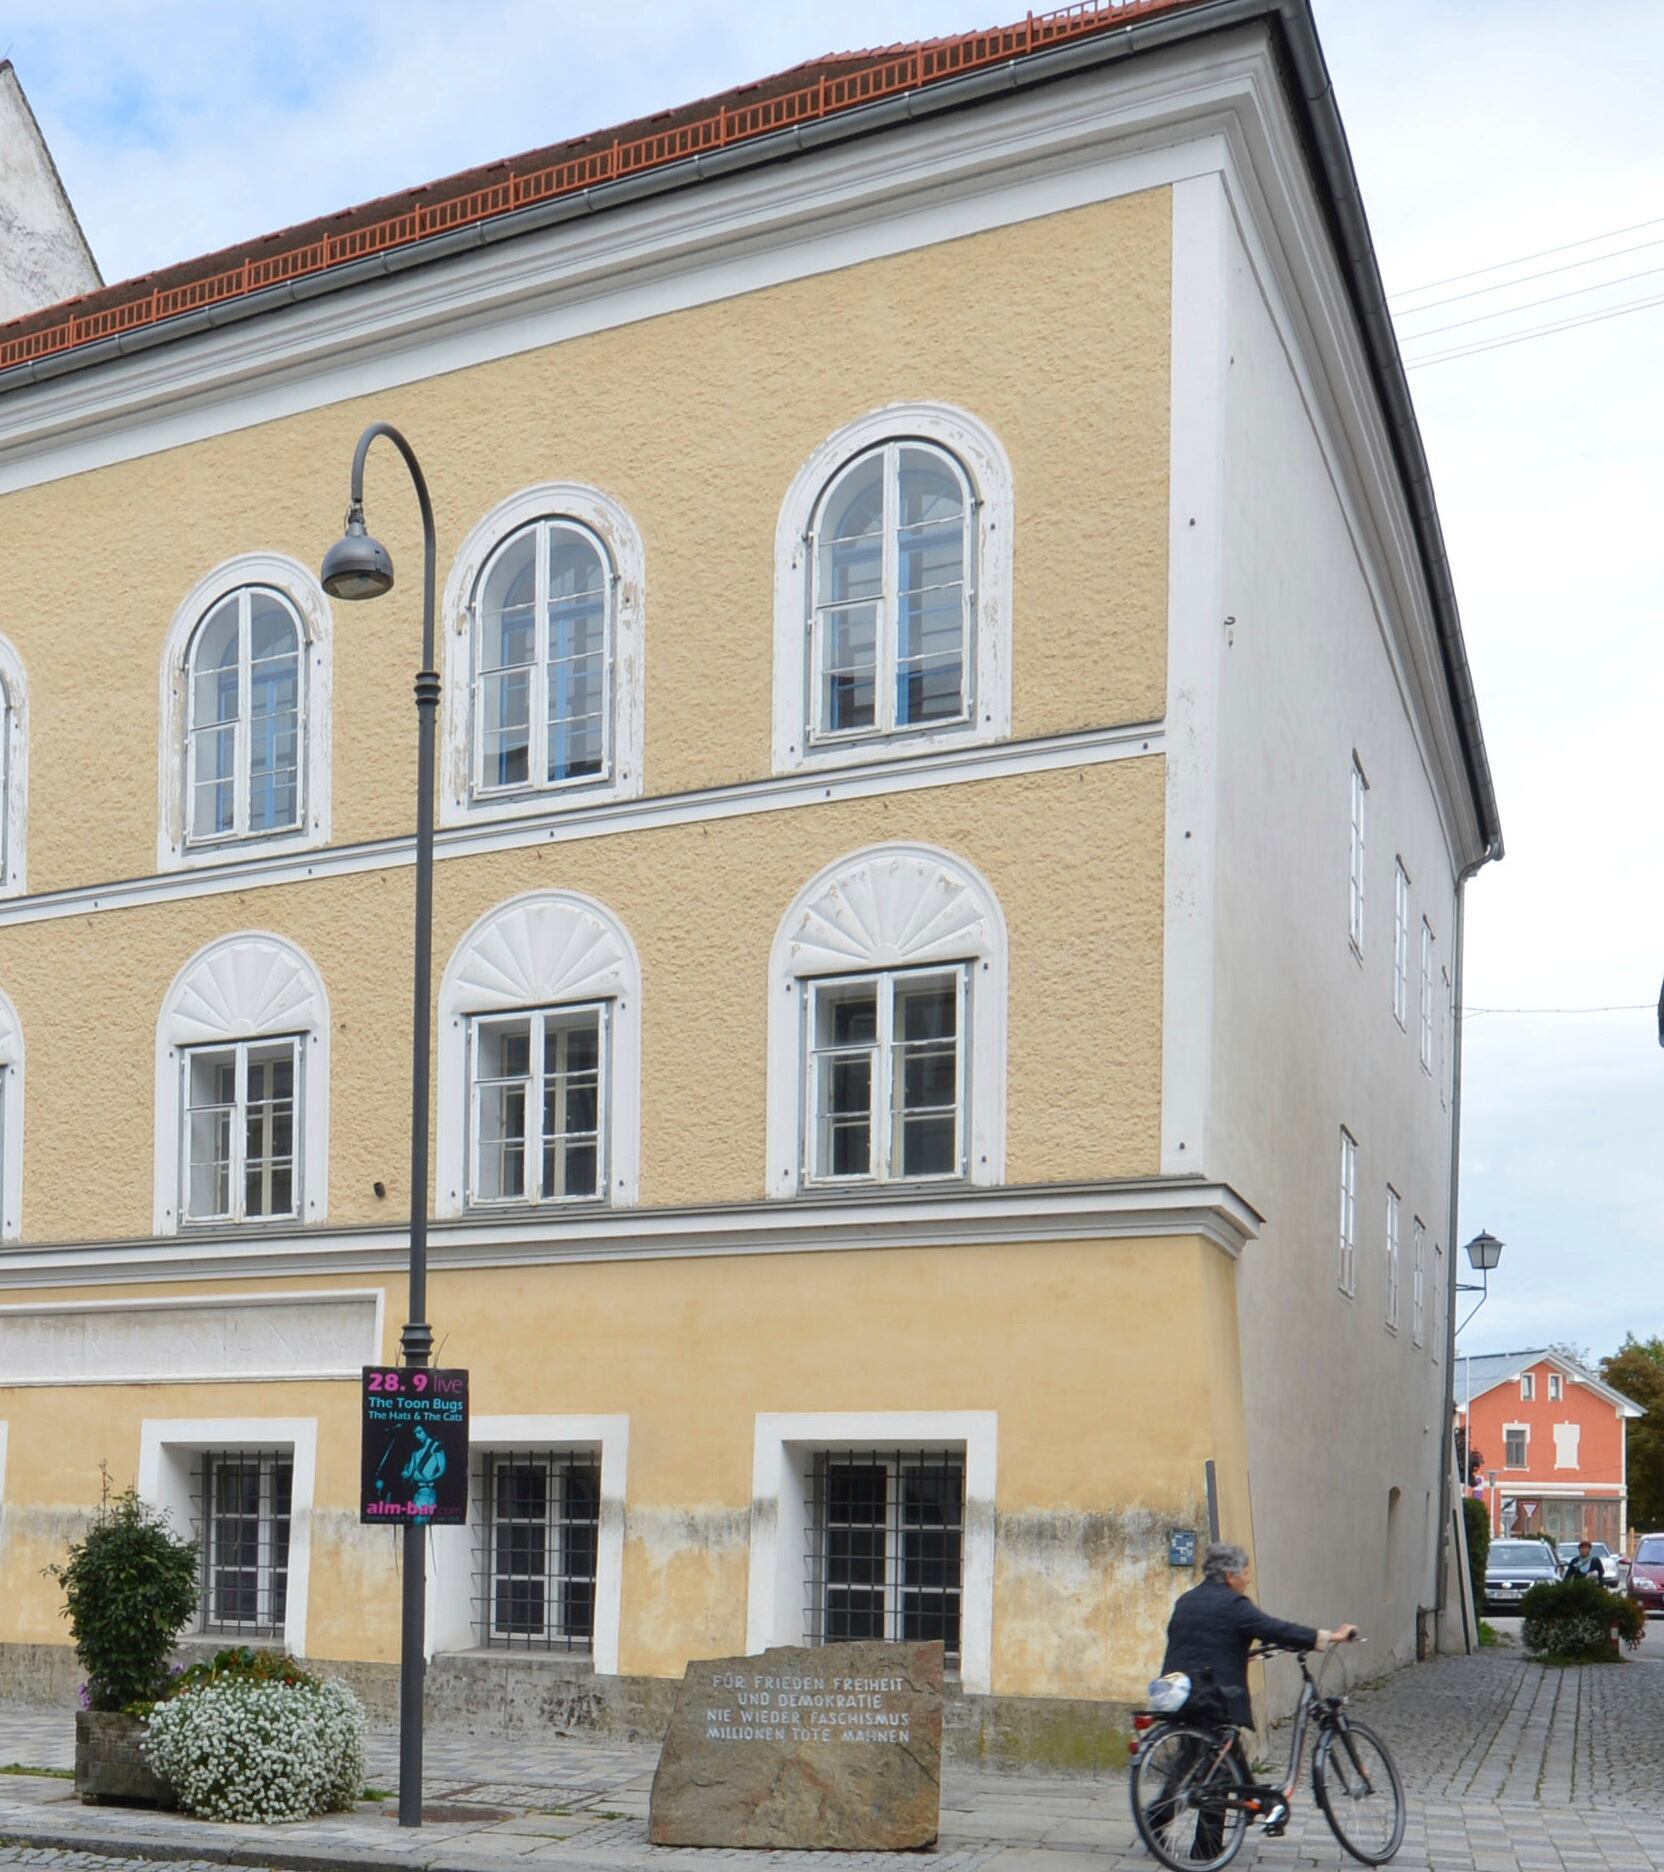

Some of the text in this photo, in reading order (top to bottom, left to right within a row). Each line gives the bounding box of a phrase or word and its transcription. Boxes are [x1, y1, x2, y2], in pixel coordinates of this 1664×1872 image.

[368, 1373, 406, 1392] 28.
[433, 1375, 463, 1393] live
[368, 1397, 463, 1412] The Toon Bugs
[368, 1410, 463, 1422] The Hats & The Cats
[712, 1672, 903, 1692] FÜR FRIEDEN FREIHEIT
[738, 1692, 882, 1708] UND DEMOKRATIE
[707, 1709, 910, 1726] NIE WIEDER FASCHISMUS
[706, 1726, 910, 1743] MILLIONEN TOTE MAHNEN
